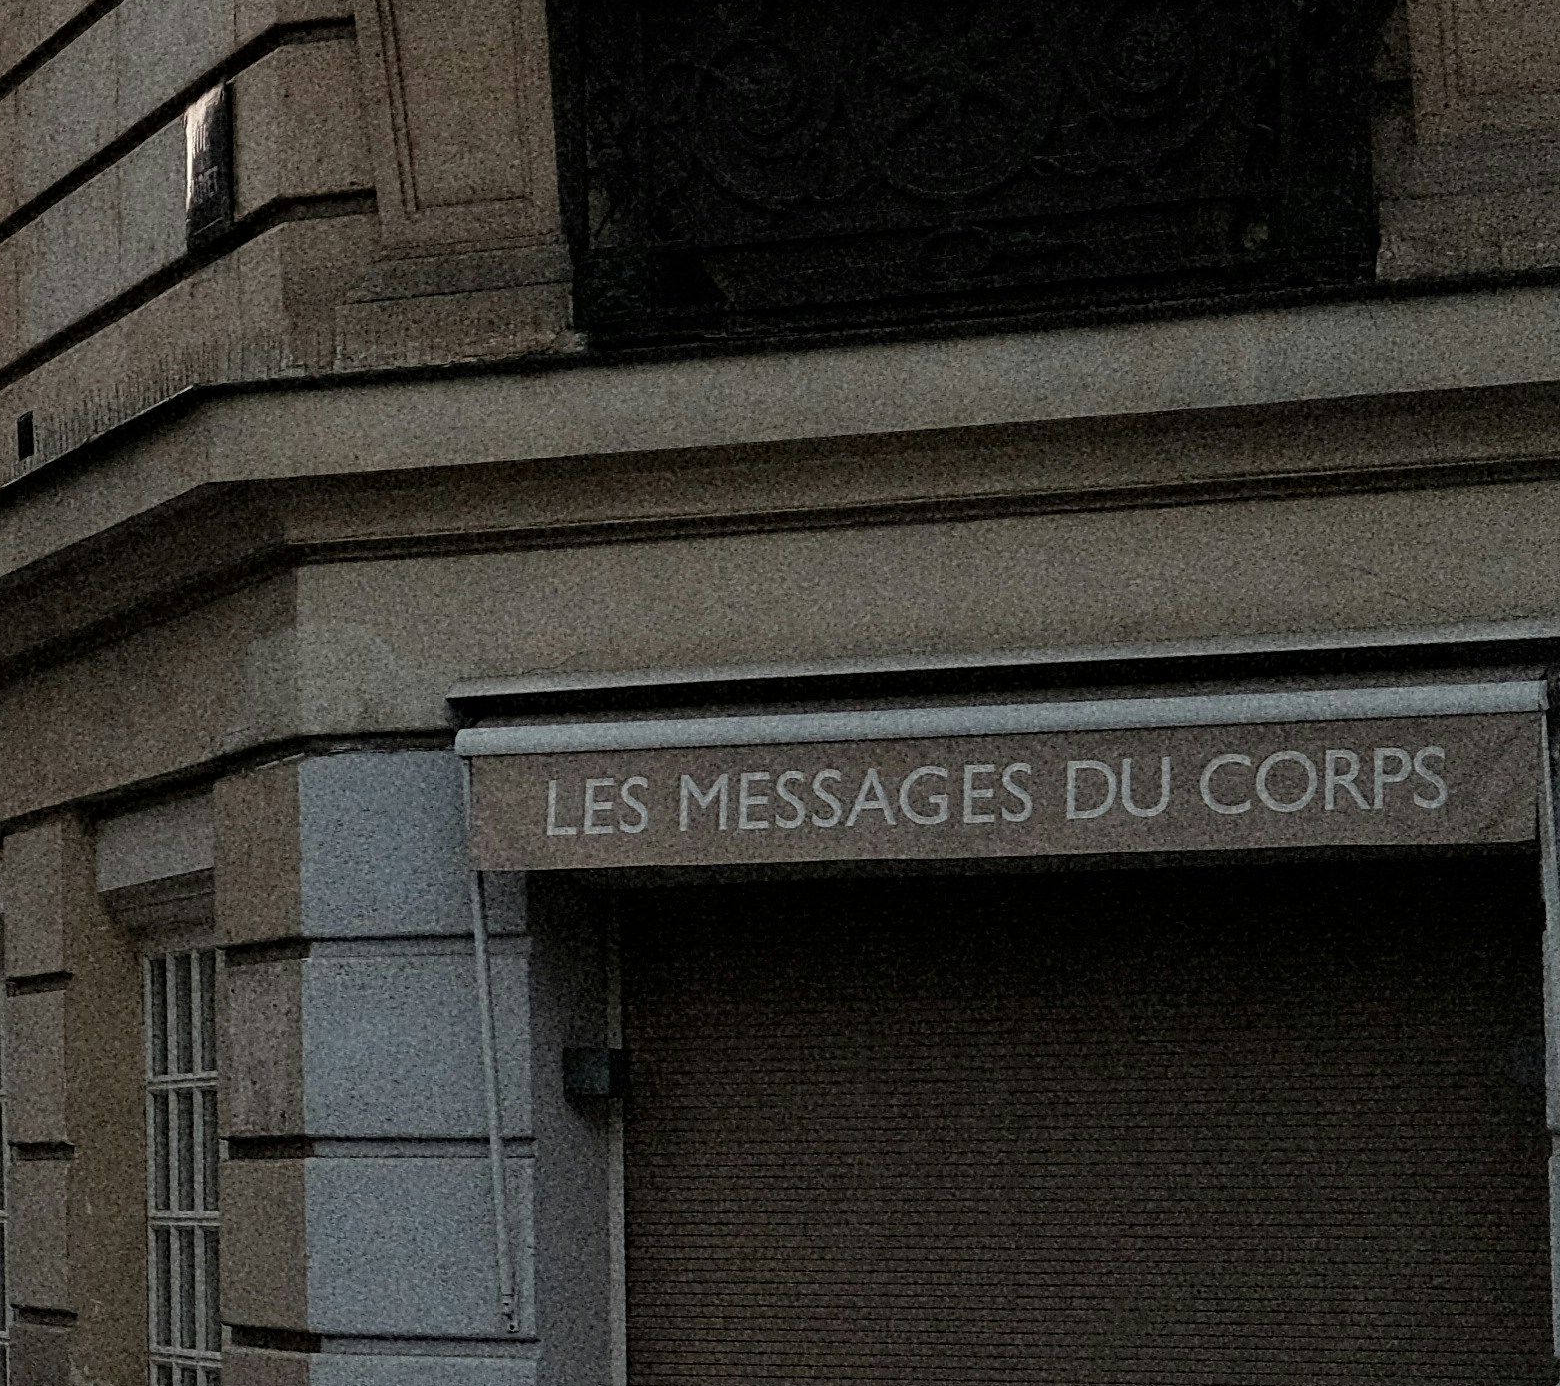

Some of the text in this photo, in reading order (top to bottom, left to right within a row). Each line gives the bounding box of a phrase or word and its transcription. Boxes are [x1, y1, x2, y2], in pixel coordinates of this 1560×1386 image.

[545, 745, 1450, 838] LES MESSAGES DU CORPS
